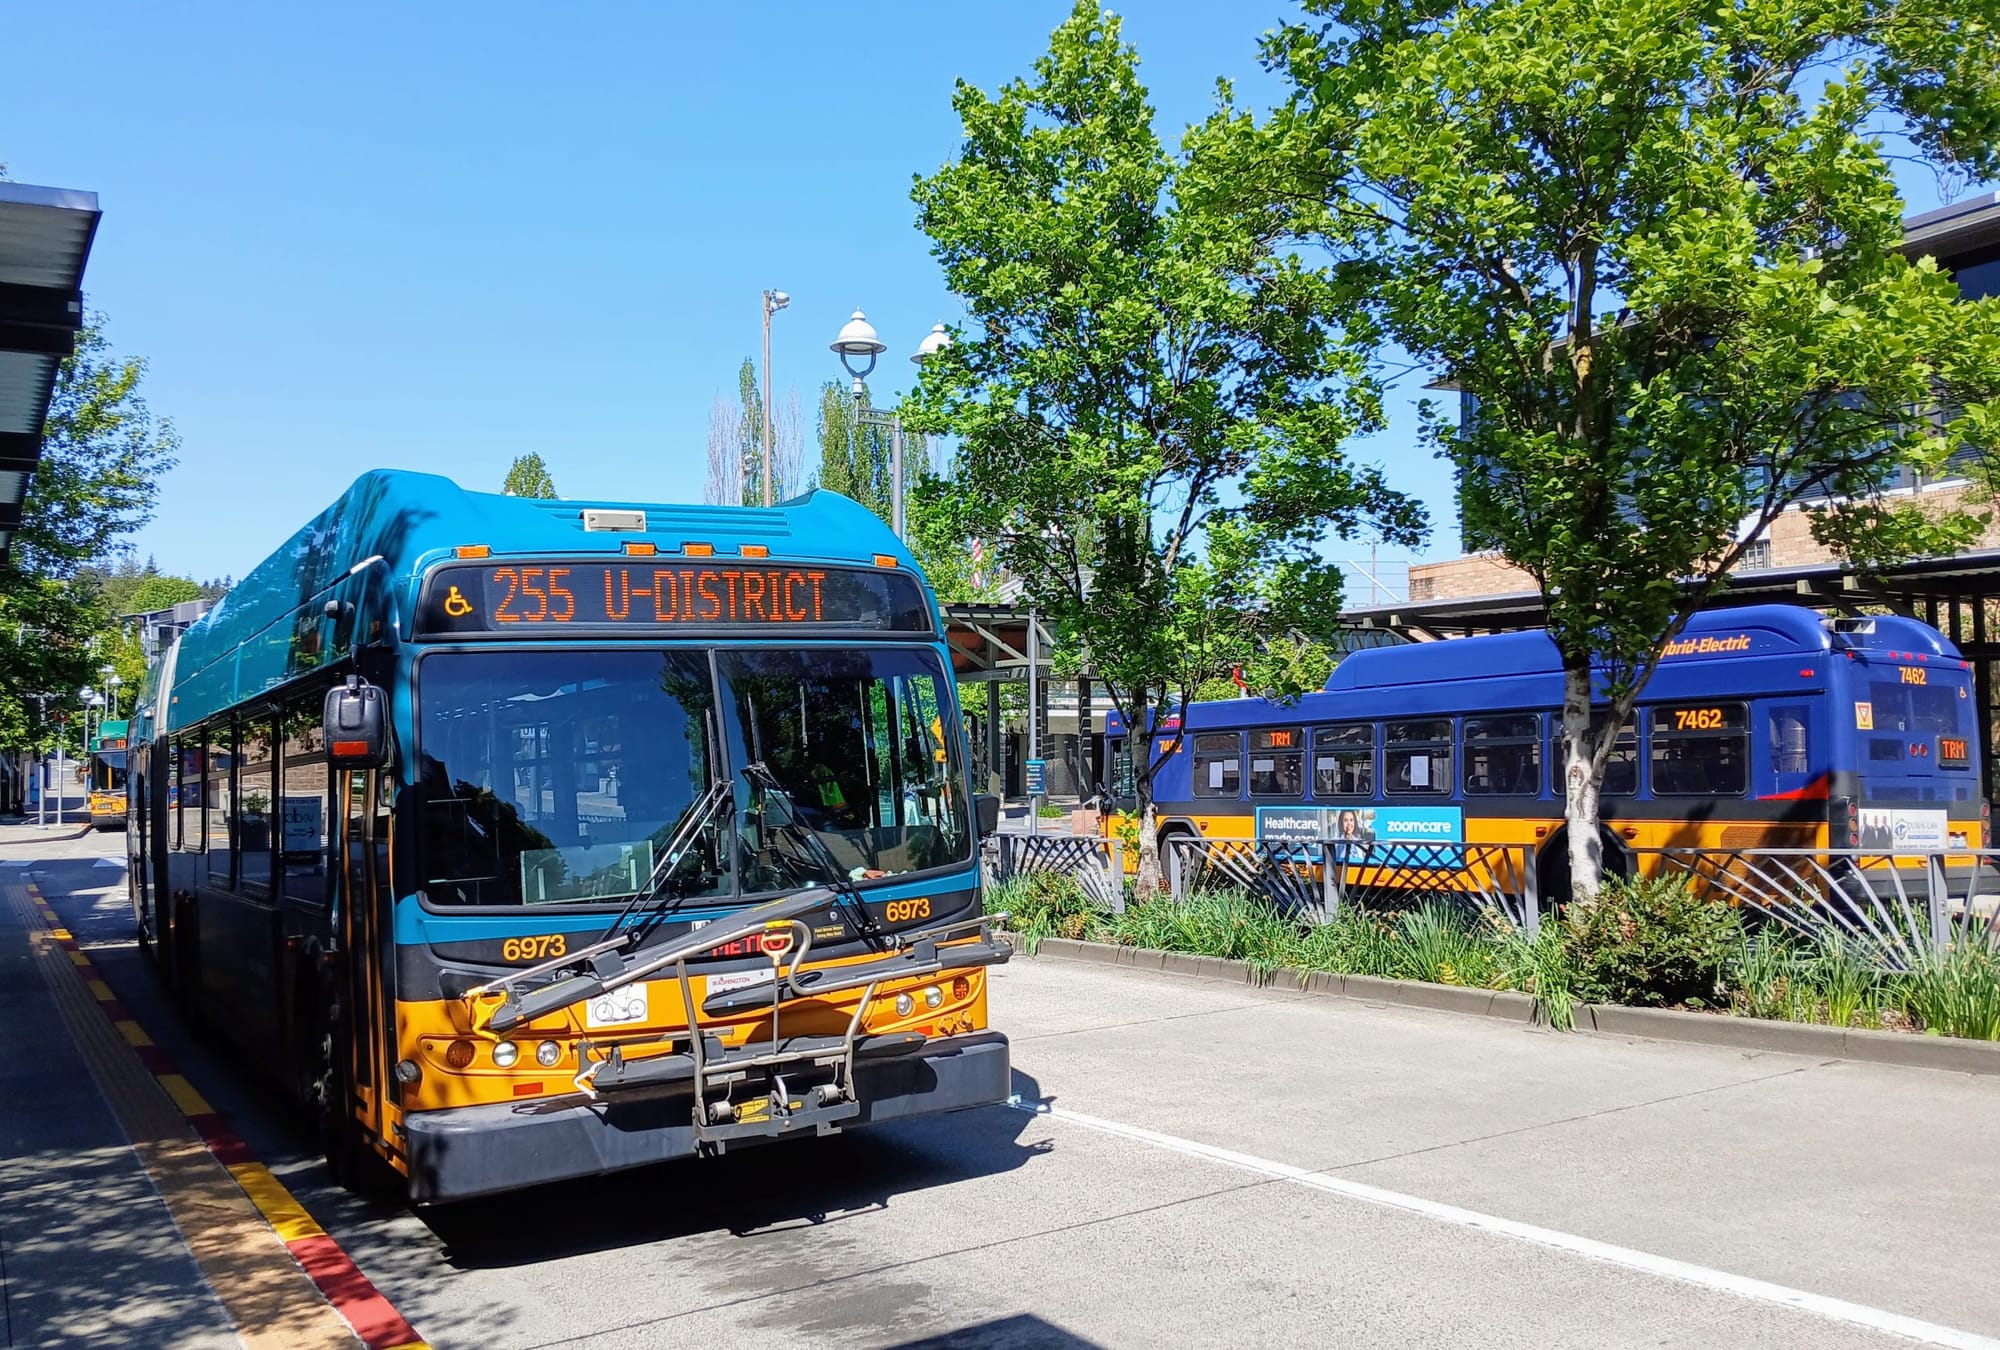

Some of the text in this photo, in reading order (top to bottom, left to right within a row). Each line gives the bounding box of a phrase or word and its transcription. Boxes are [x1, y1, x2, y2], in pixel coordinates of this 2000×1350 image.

[493, 568, 825, 622] 255 U-DISTRICT
[1655, 634, 1751, 659] ybrid-Electric
[1899, 666, 1927, 685] 7462
[1675, 708, 1723, 730] 7462
[1270, 731, 1290, 747] TRM
[1942, 740, 1966, 759] TRM
[1264, 816, 1321, 831] Healthcare,
[1387, 820, 1452, 833] zoomcare
[886, 898, 931, 921] 6973
[503, 934, 566, 961] 6973
[712, 976, 751, 986] WASHINGTON
